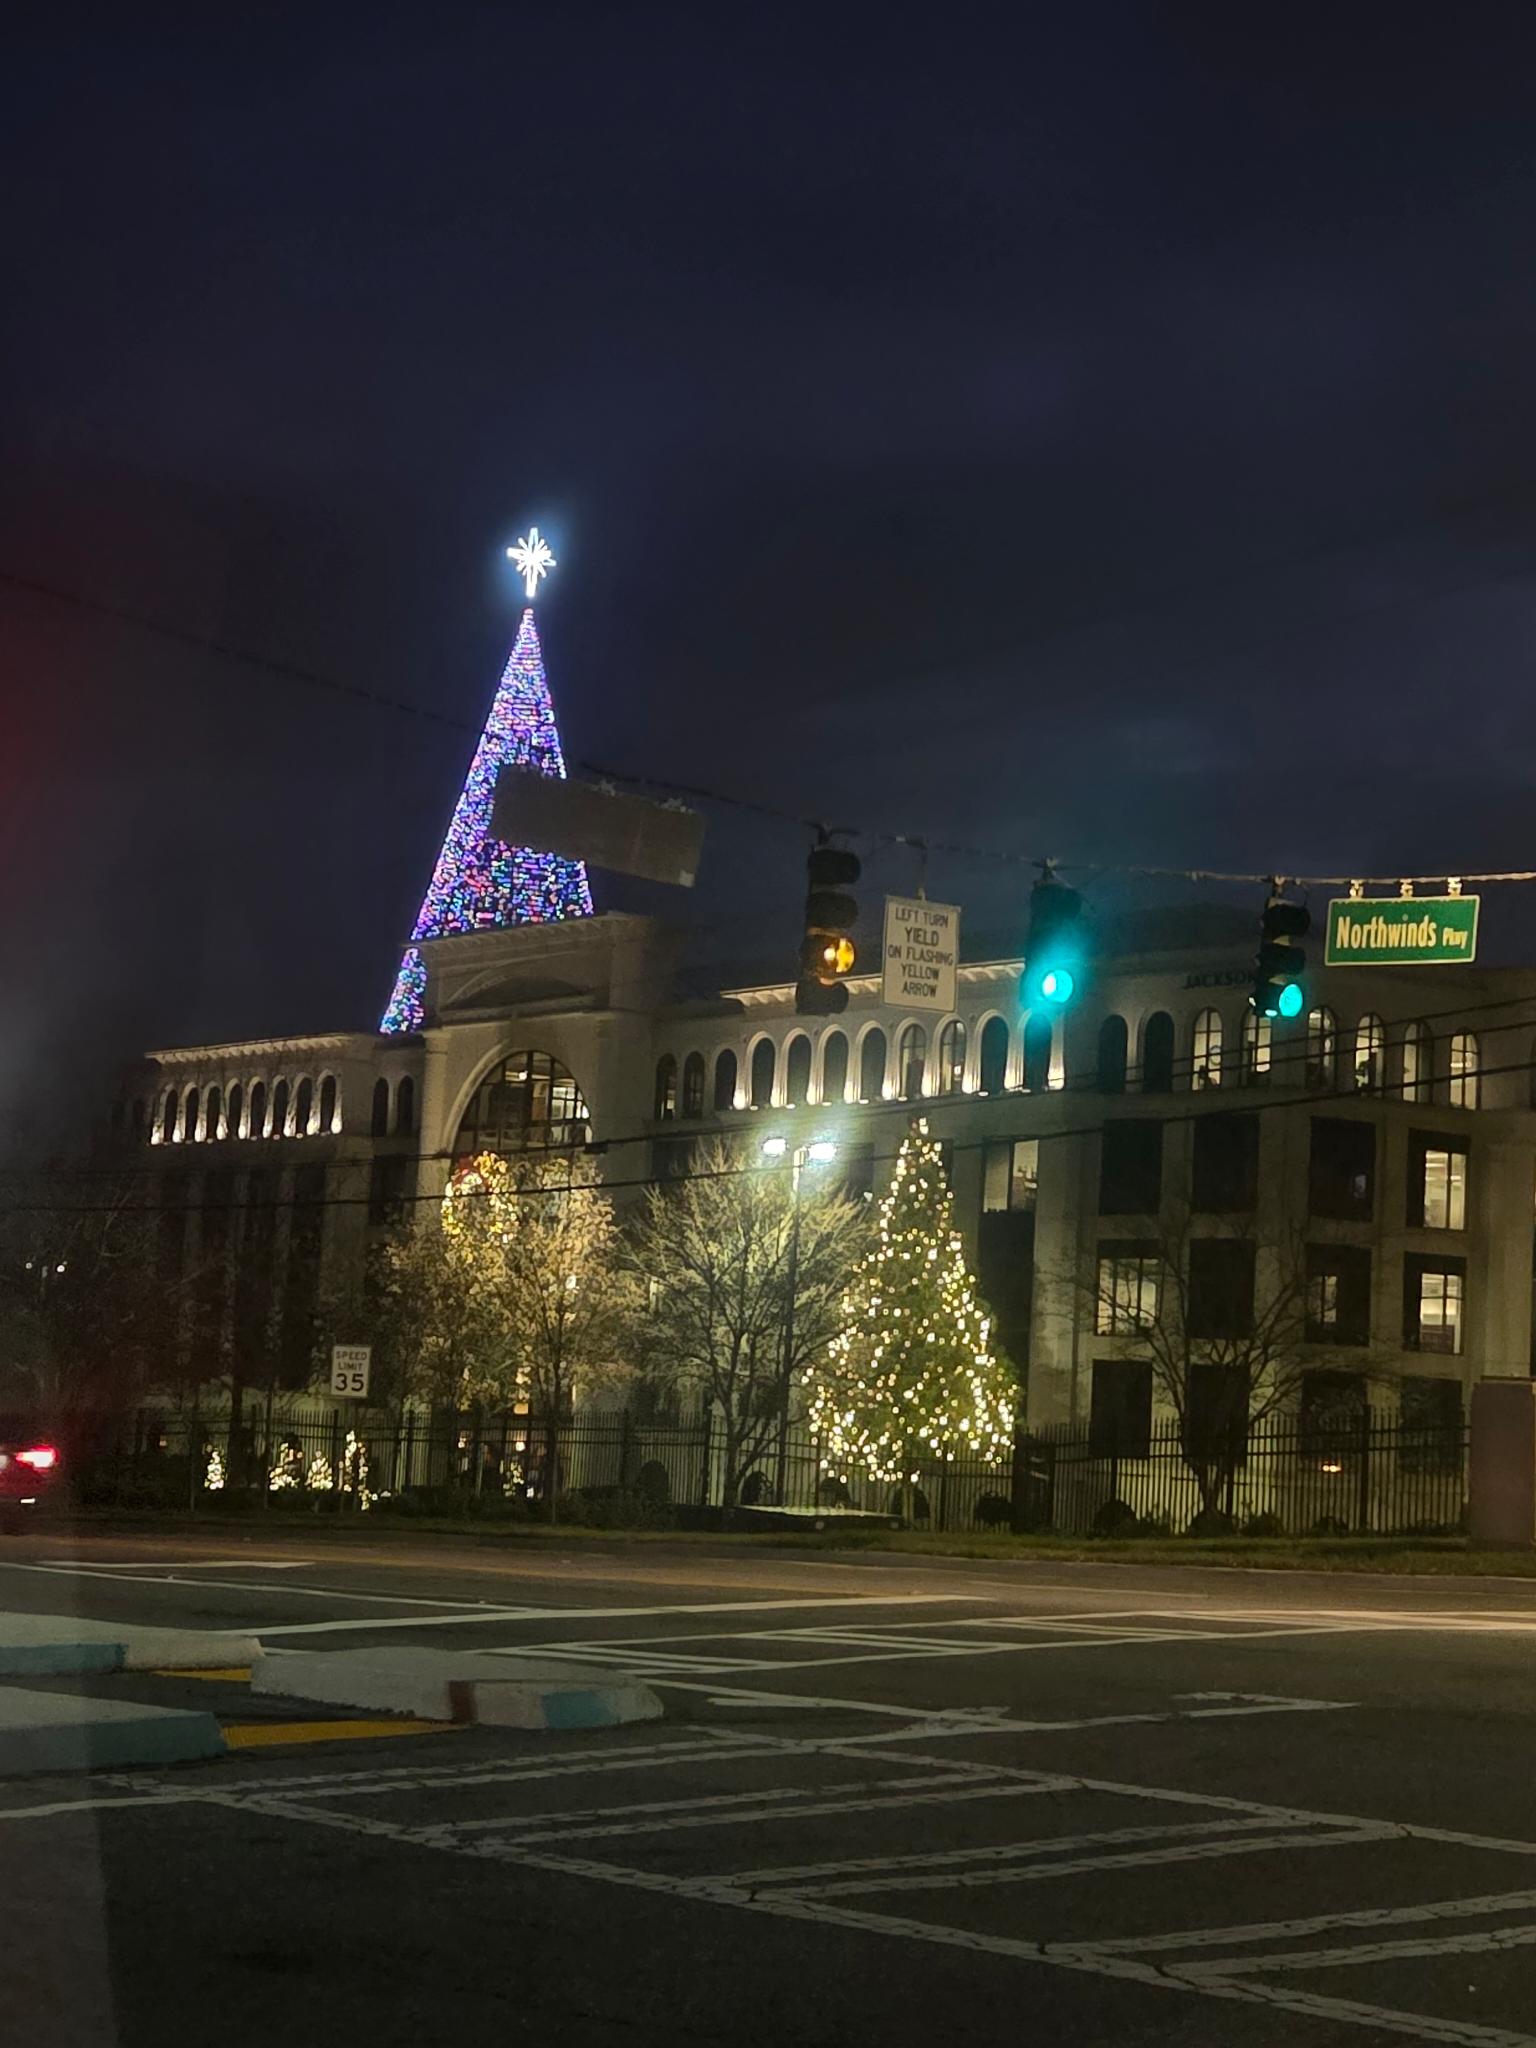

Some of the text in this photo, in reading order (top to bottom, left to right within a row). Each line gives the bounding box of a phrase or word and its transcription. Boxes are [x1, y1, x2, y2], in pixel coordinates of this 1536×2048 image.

[895, 907, 949, 928] LEFT TURN
[905, 927, 940, 947] YIELD
[1336, 914, 1437, 949] Northwinds
[887, 944, 953, 966] ON FLASHING
[901, 962, 940, 981] YELLOW
[902, 981, 937, 998] ARROW
[336, 1351, 367, 1360] SPEED
[338, 1361, 363, 1370] LIMIT
[335, 1372, 364, 1392] 35
